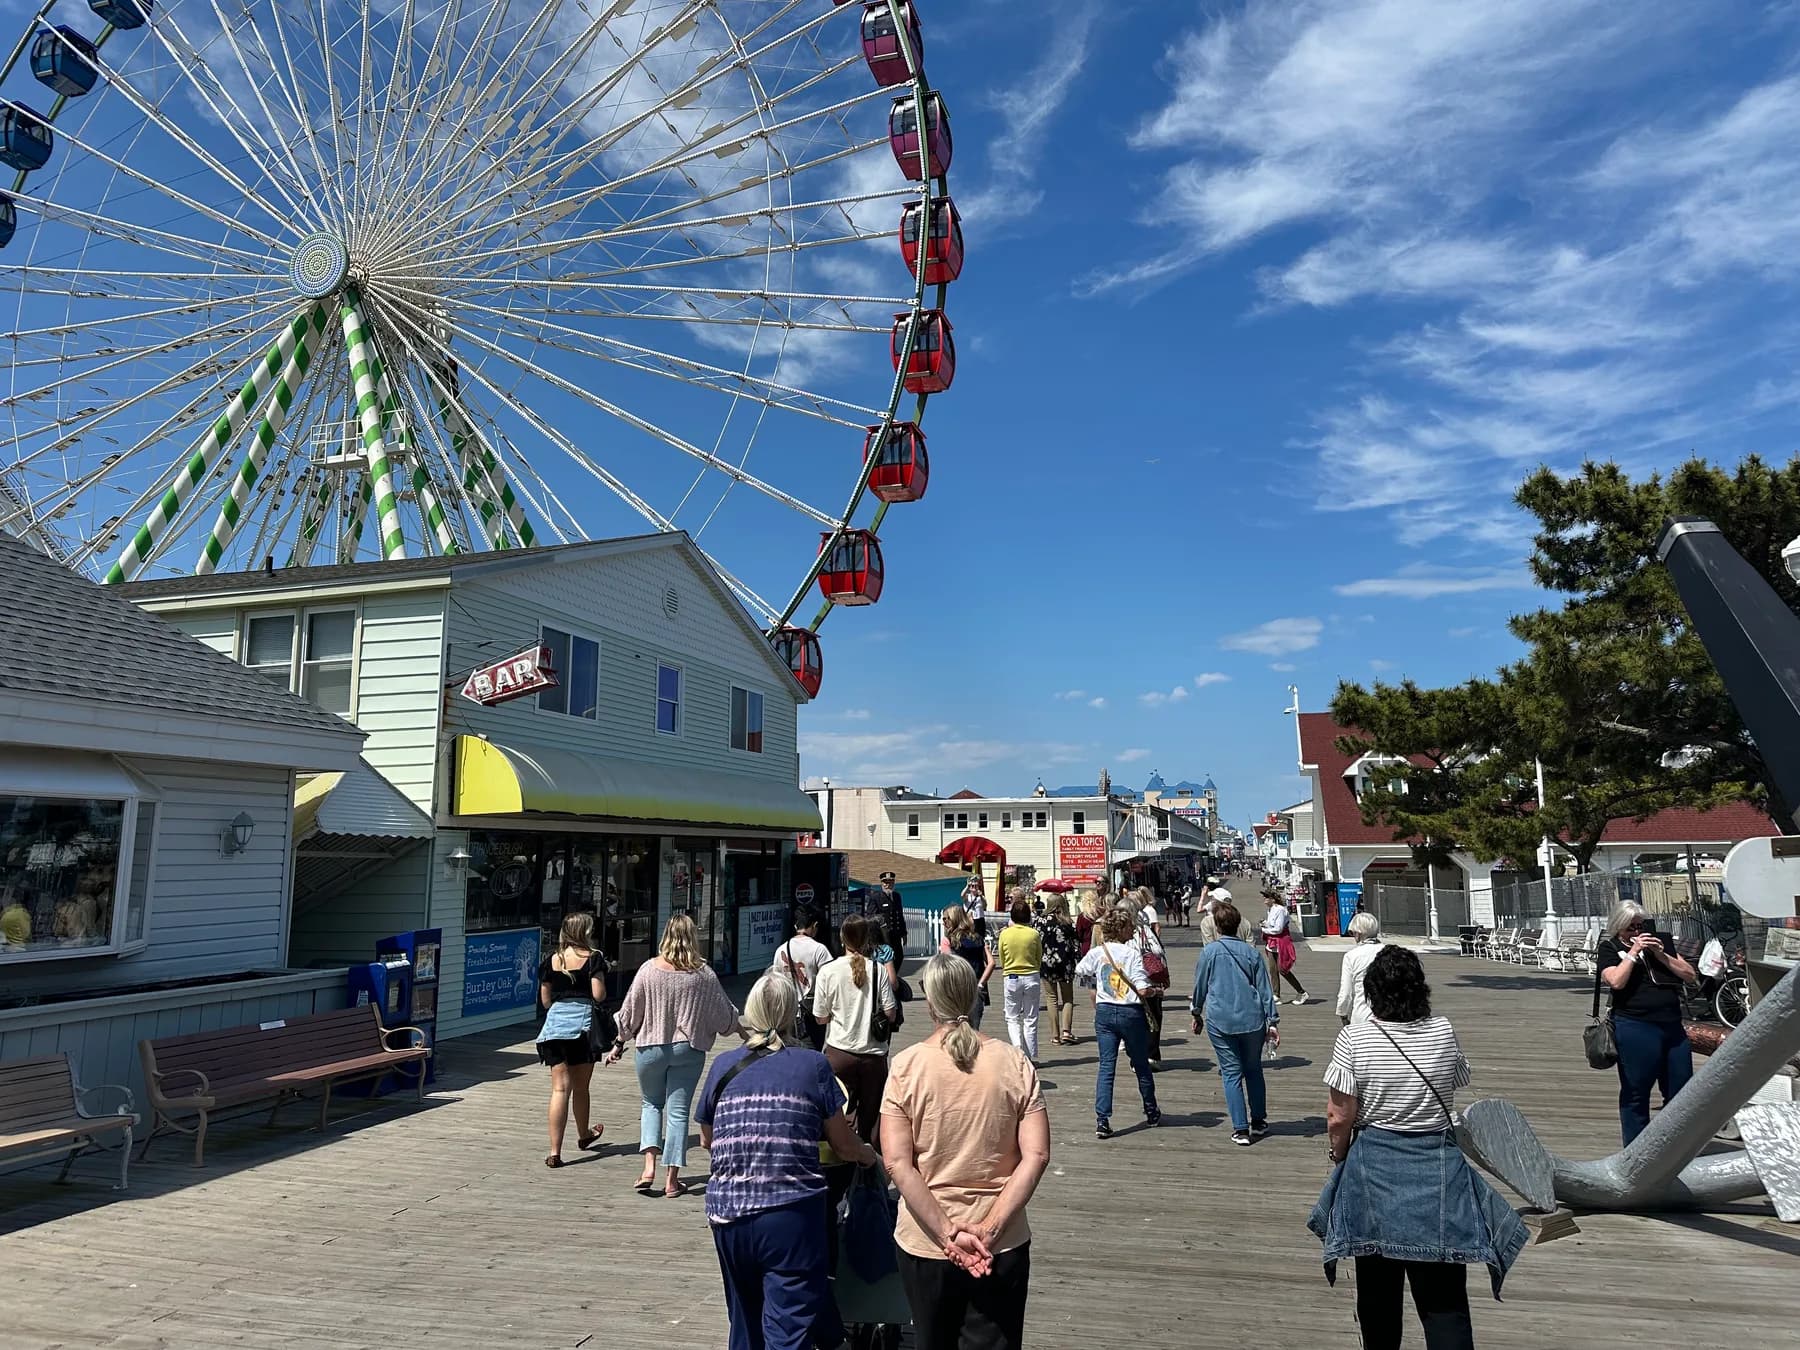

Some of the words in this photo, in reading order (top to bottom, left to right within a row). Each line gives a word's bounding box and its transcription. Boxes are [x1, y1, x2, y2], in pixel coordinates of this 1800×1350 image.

[473, 659, 538, 697] BAR
[1175, 808, 1201, 816] RIDES
[1062, 838, 1080, 846] COOL
[1081, 837, 1103, 846] TOPICS
[468, 945, 488, 955] Proudly
[489, 943, 507, 953] Serving
[467, 957, 484, 967] Fresh
[484, 955, 500, 965] Local
[500, 955, 513, 963] Beer
[466, 980, 496, 995] Burley
[497, 977, 512, 990] Oak
[488, 991, 512, 1001] Company
